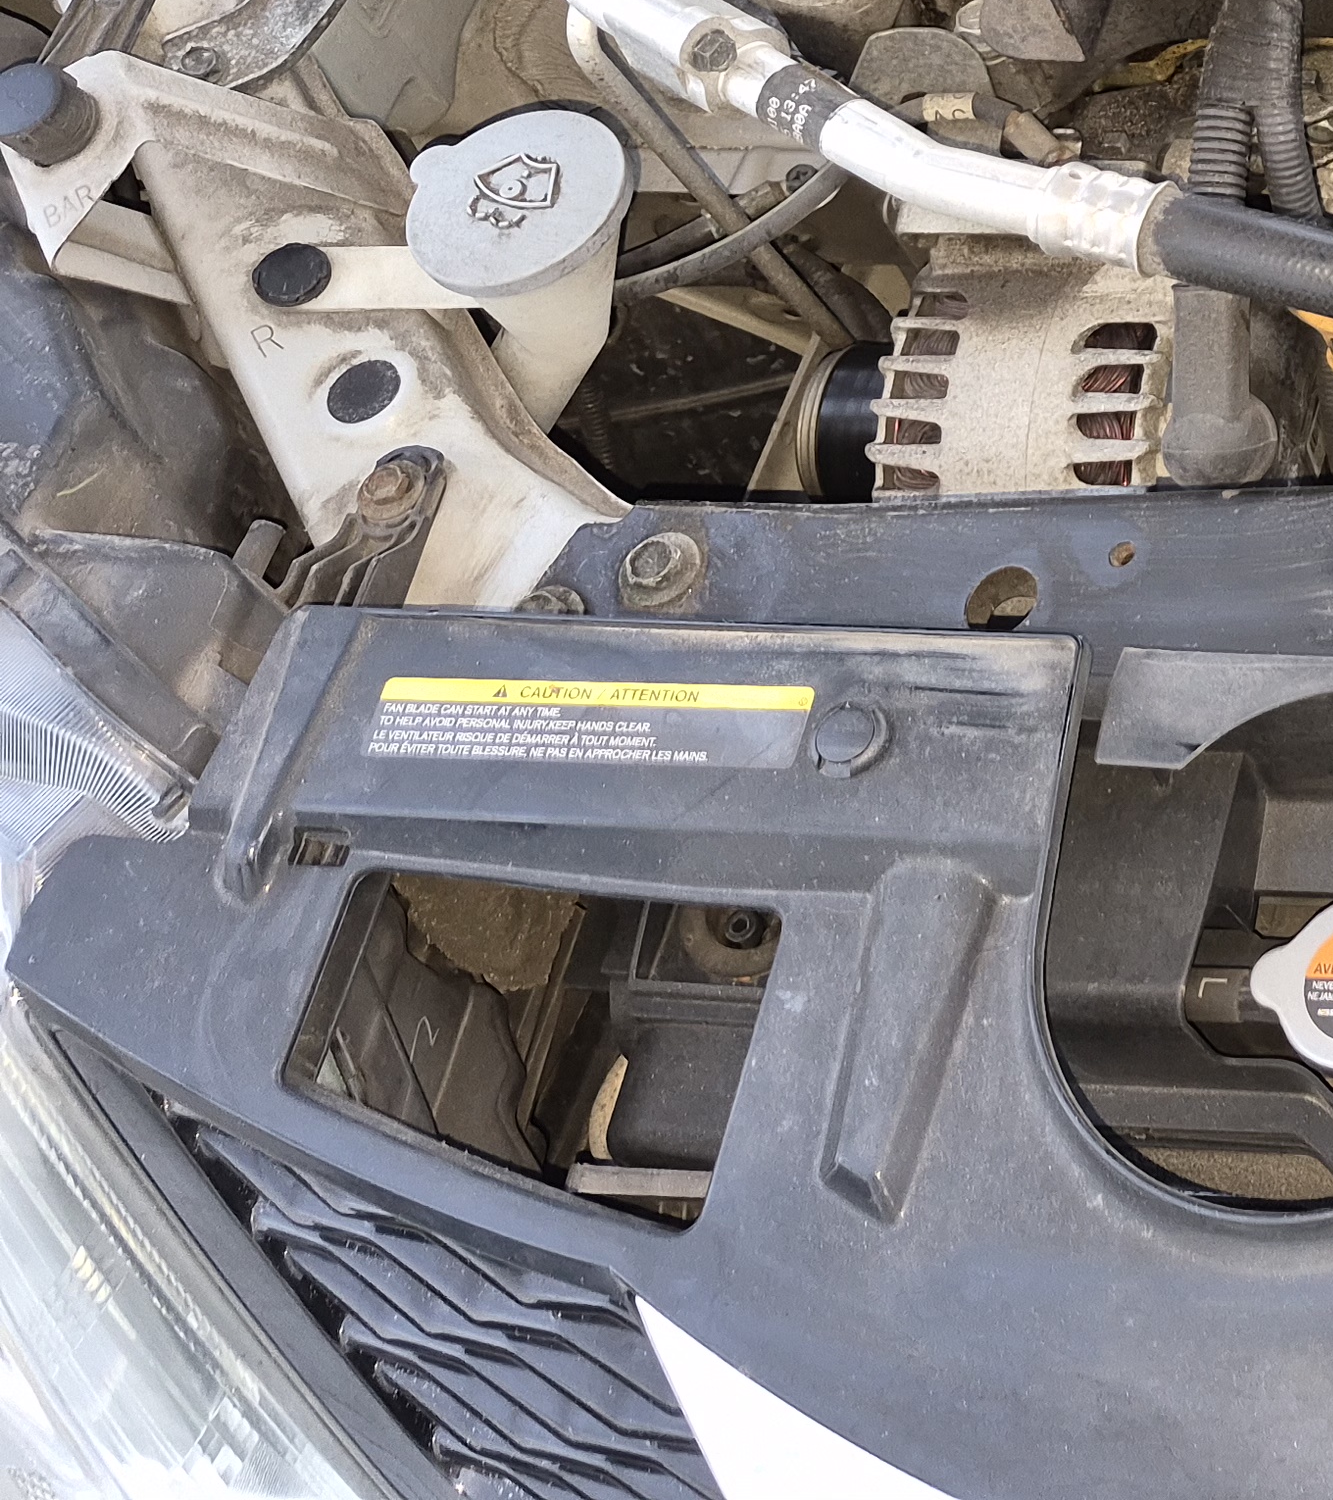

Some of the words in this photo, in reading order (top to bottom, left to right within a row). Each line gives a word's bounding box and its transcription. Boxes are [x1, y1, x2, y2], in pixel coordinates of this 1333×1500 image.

[42, 184, 97, 229] BAR
[249, 324, 285, 358] R
[520, 686, 592, 700] CAUTION
[610, 688, 700, 703] ATTENTION
[383, 702, 405, 714] FAN
[405, 703, 439, 714] BLADE
[440, 704, 467, 715] CAN
[464, 705, 498, 716] START
[497, 706, 513, 716] AT
[511, 706, 537, 717] ANY
[536, 708, 561, 718] TIME.
[379, 715, 394, 726] TO
[395, 716, 423, 727] HELP
[422, 717, 456, 728] AVOID
[455, 717, 511, 730] PERSONAL
[576, 721, 614, 732] HANDS
[615, 722, 651, 733] CLEAR.
[373, 729, 387, 740] LE
[388, 729, 454, 743] VENTILATEUR
[454, 732, 496, 744] RISQUE
[495, 733, 515, 744] DE
[511, 732, 571, 746] DÉMARRER
[580, 735, 609, 747] TOUT
[608, 736, 657, 748] MOMENT.
[368, 741, 402, 754] POUR
[400, 741, 436, 755] ÉVITER
[435, 745, 471, 756] TOUTE
[471, 746, 528, 759] BLESSURE,
[529, 748, 545, 758] NE
[545, 748, 568, 759] PAS
[568, 749, 584, 759] EN
[583, 749, 651, 762] APPROCHER
[651, 751, 672, 762] LES
[672, 752, 708, 763] MAINS.
[1307, 990, 1320, 1000] NE
